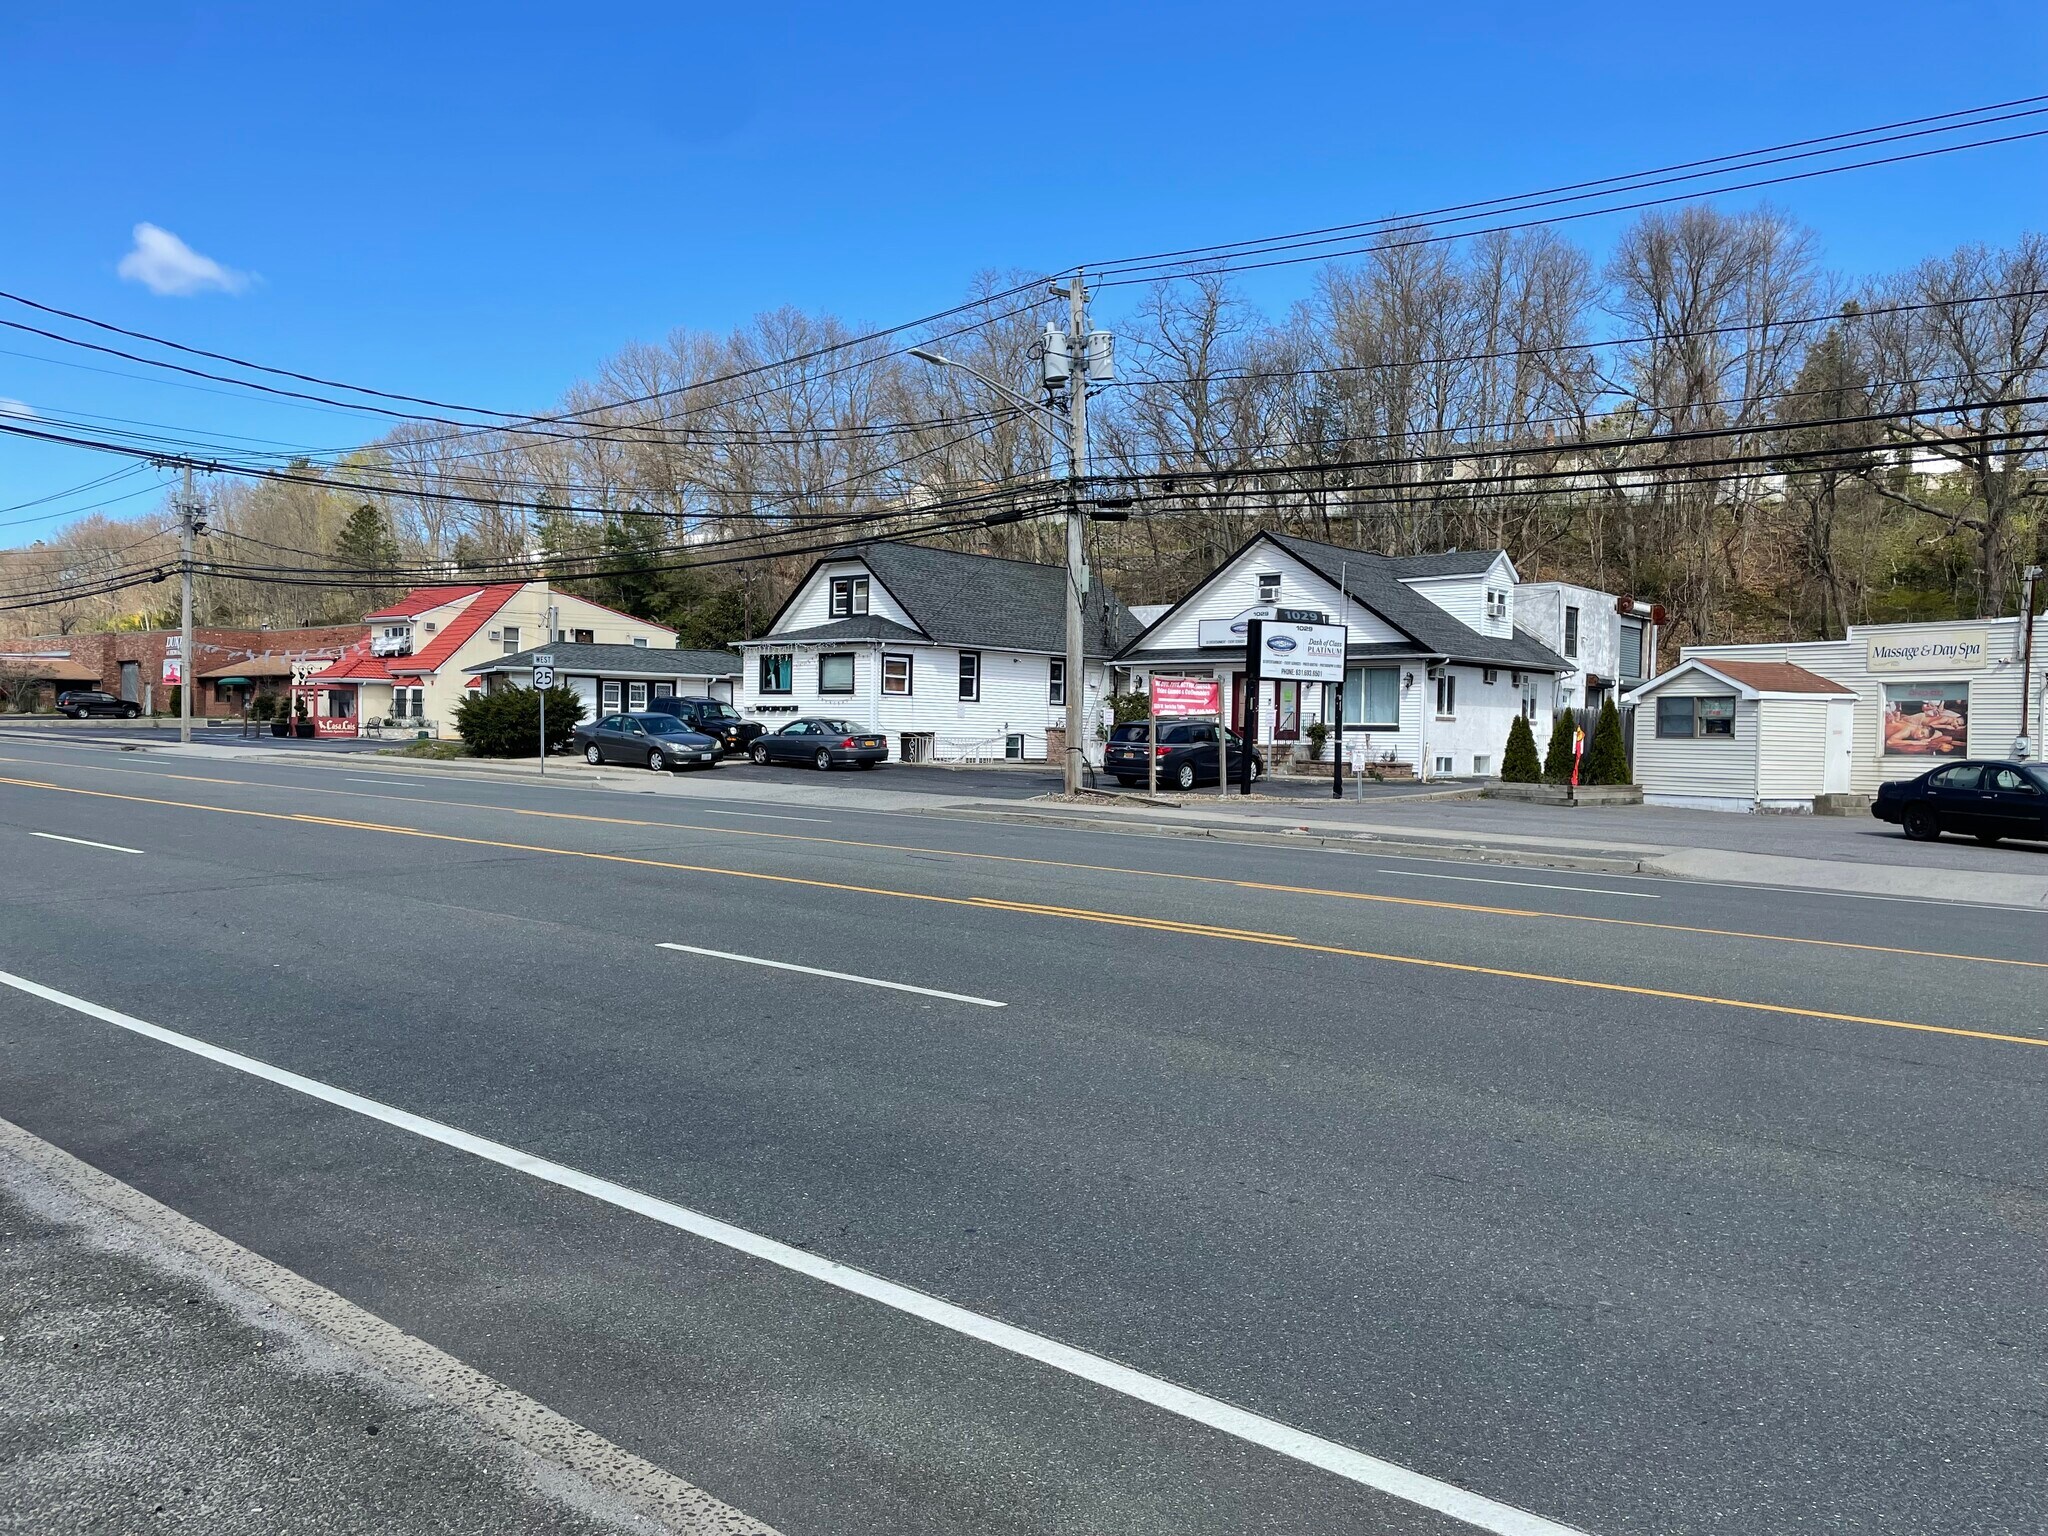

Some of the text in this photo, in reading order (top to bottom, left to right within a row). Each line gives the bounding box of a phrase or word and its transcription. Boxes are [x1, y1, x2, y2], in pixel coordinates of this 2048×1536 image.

[1284, 611, 1318, 621] 1029
[1308, 638, 1322, 646] Dash
[1322, 639, 1329, 647] of
[1328, 639, 1342, 647] Class
[1872, 642, 1980, 660] Massage & Day Spa
[536, 672, 551, 684] 25
[326, 720, 342, 730] Casa
